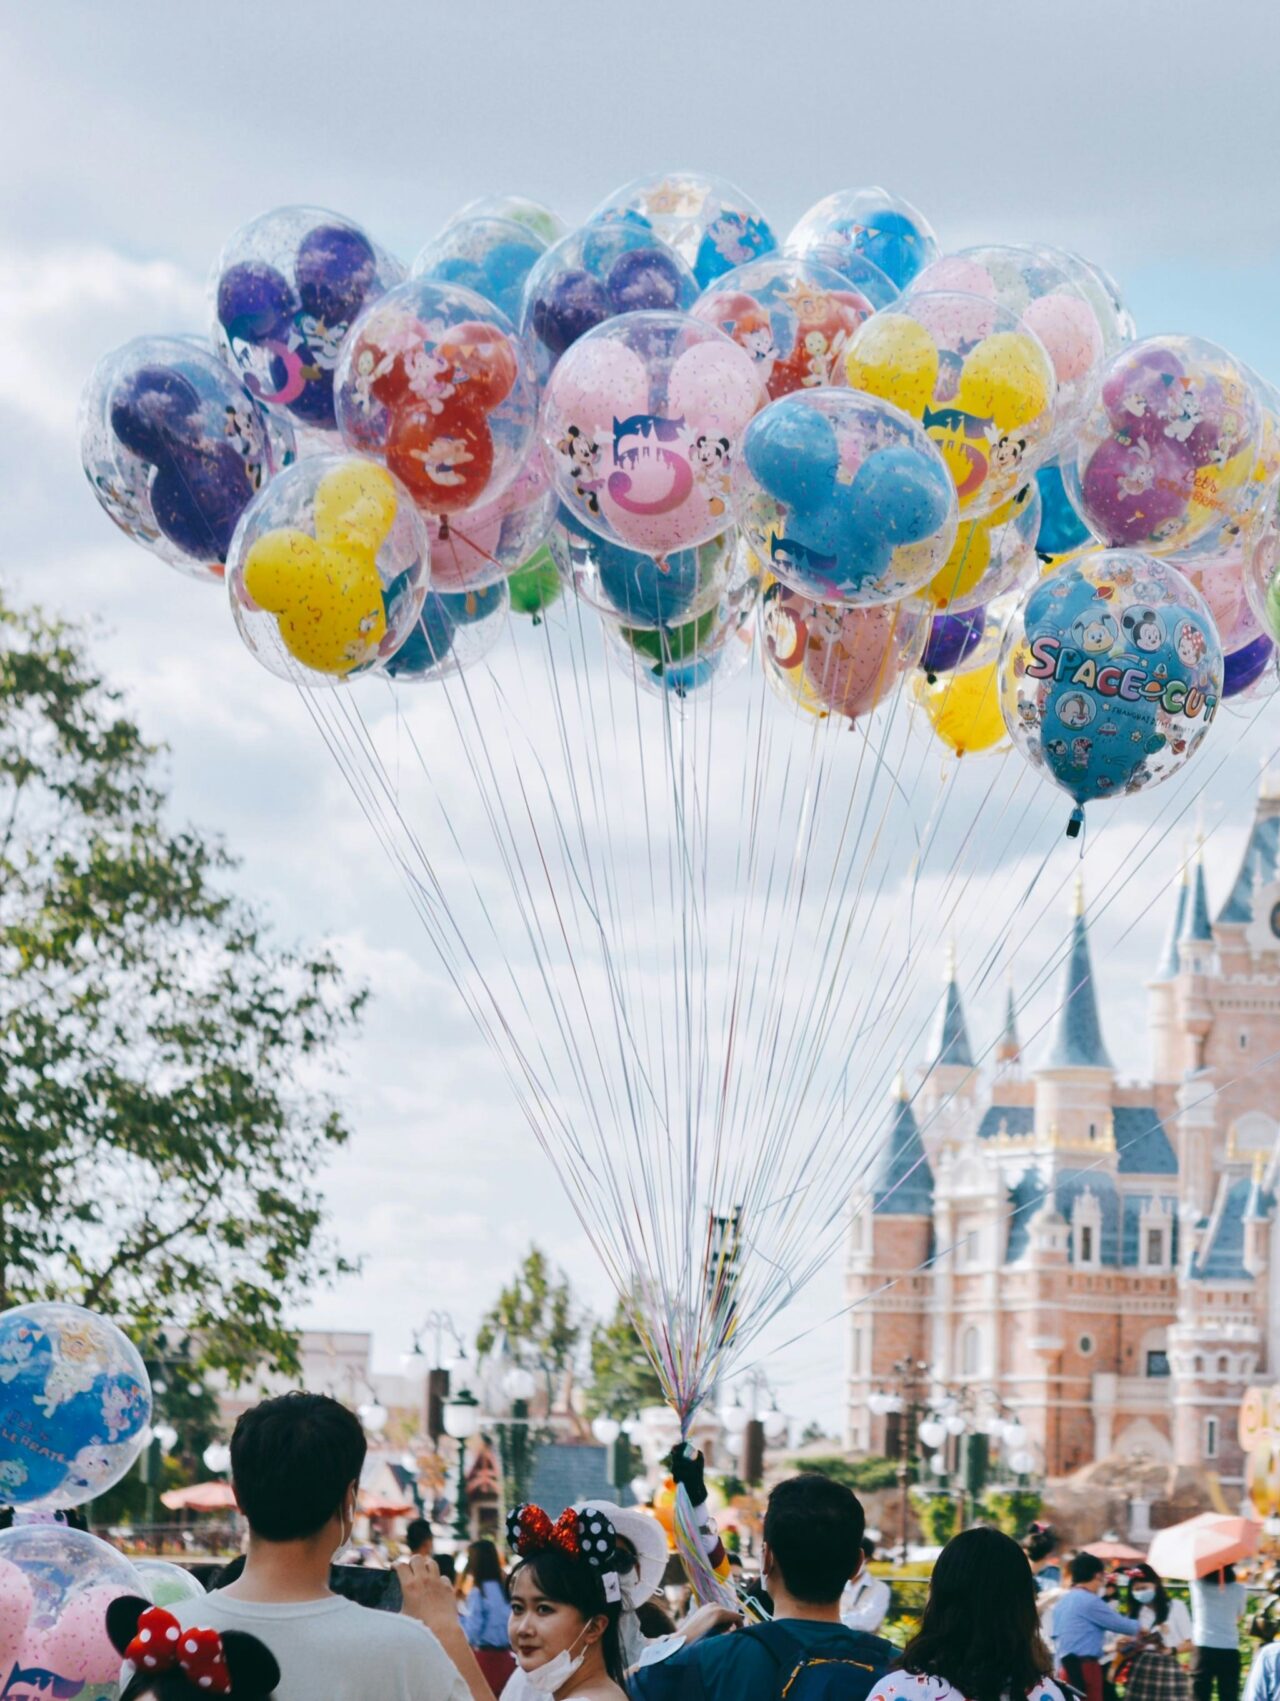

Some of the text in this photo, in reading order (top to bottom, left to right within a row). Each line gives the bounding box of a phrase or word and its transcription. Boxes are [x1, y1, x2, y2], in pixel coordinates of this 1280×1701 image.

[608, 414, 693, 516] 5
[1025, 636, 1217, 724] SPACE CUT
[1, 1427, 65, 1463] LEBRATE
